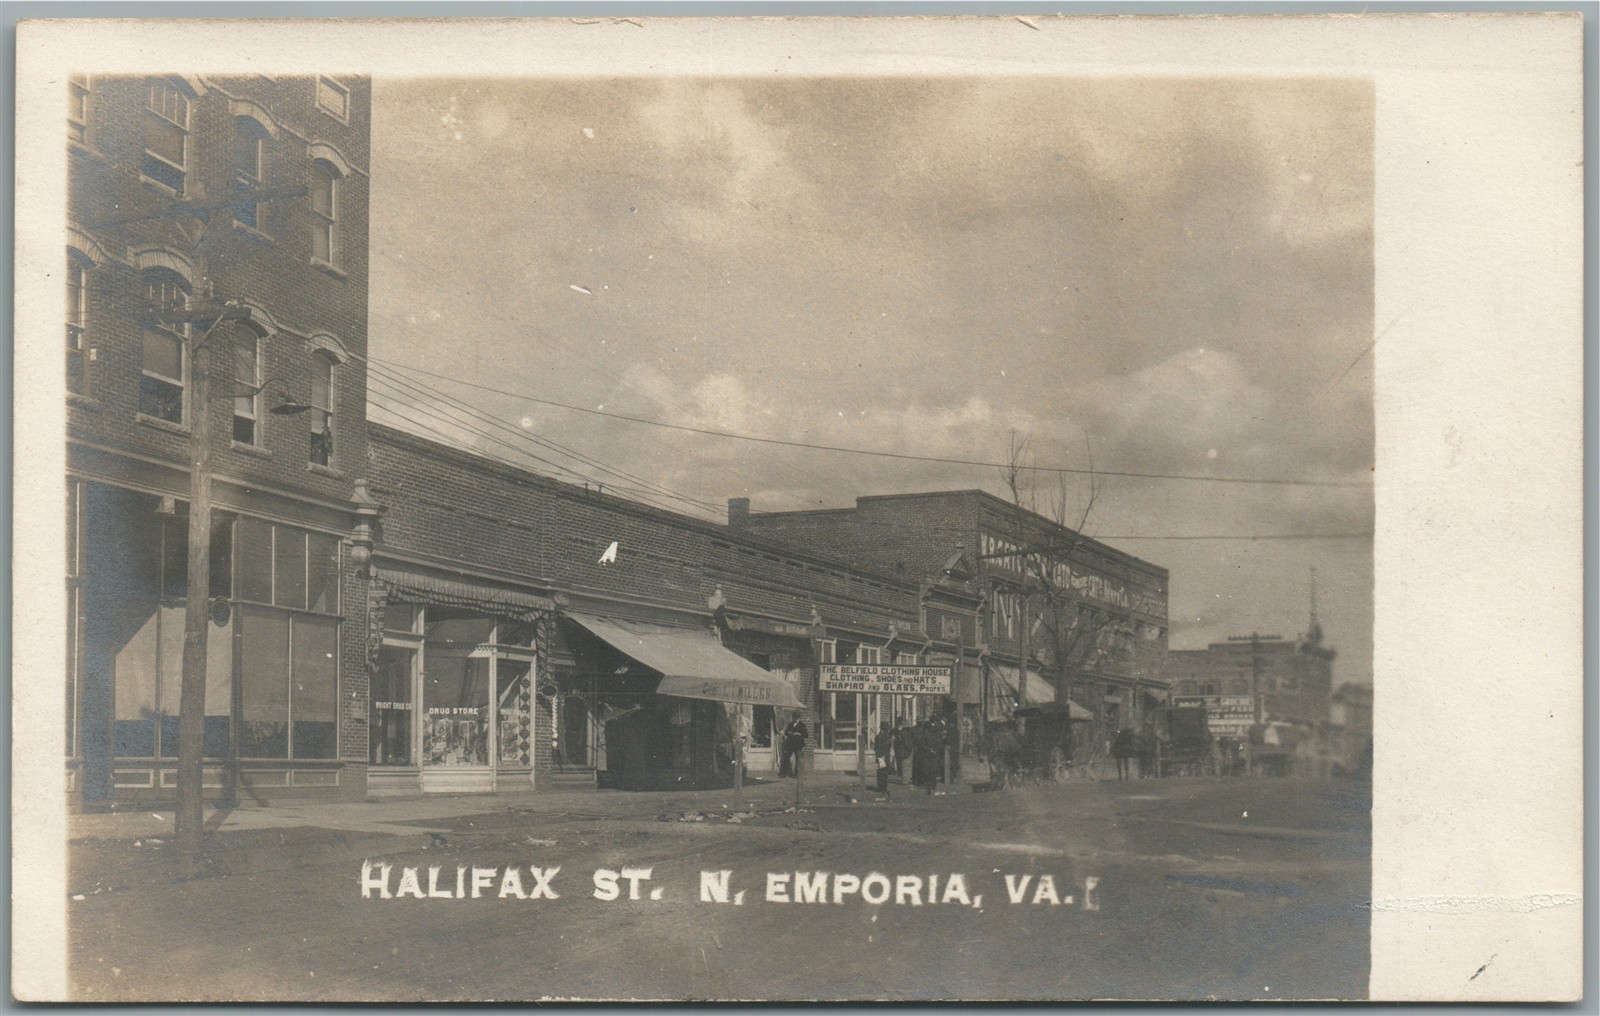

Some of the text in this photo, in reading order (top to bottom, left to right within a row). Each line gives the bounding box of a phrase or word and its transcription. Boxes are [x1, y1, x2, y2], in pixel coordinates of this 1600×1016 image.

[881, 667, 920, 675] CLOTHING
[922, 668, 949, 676] HOUSE
[876, 675, 903, 683] SHOES
[826, 681, 864, 690] SHAPIRO
[738, 685, 771, 700] MILLER
[393, 702, 405, 710] DRUG
[429, 707, 479, 715] DRUG STORE
